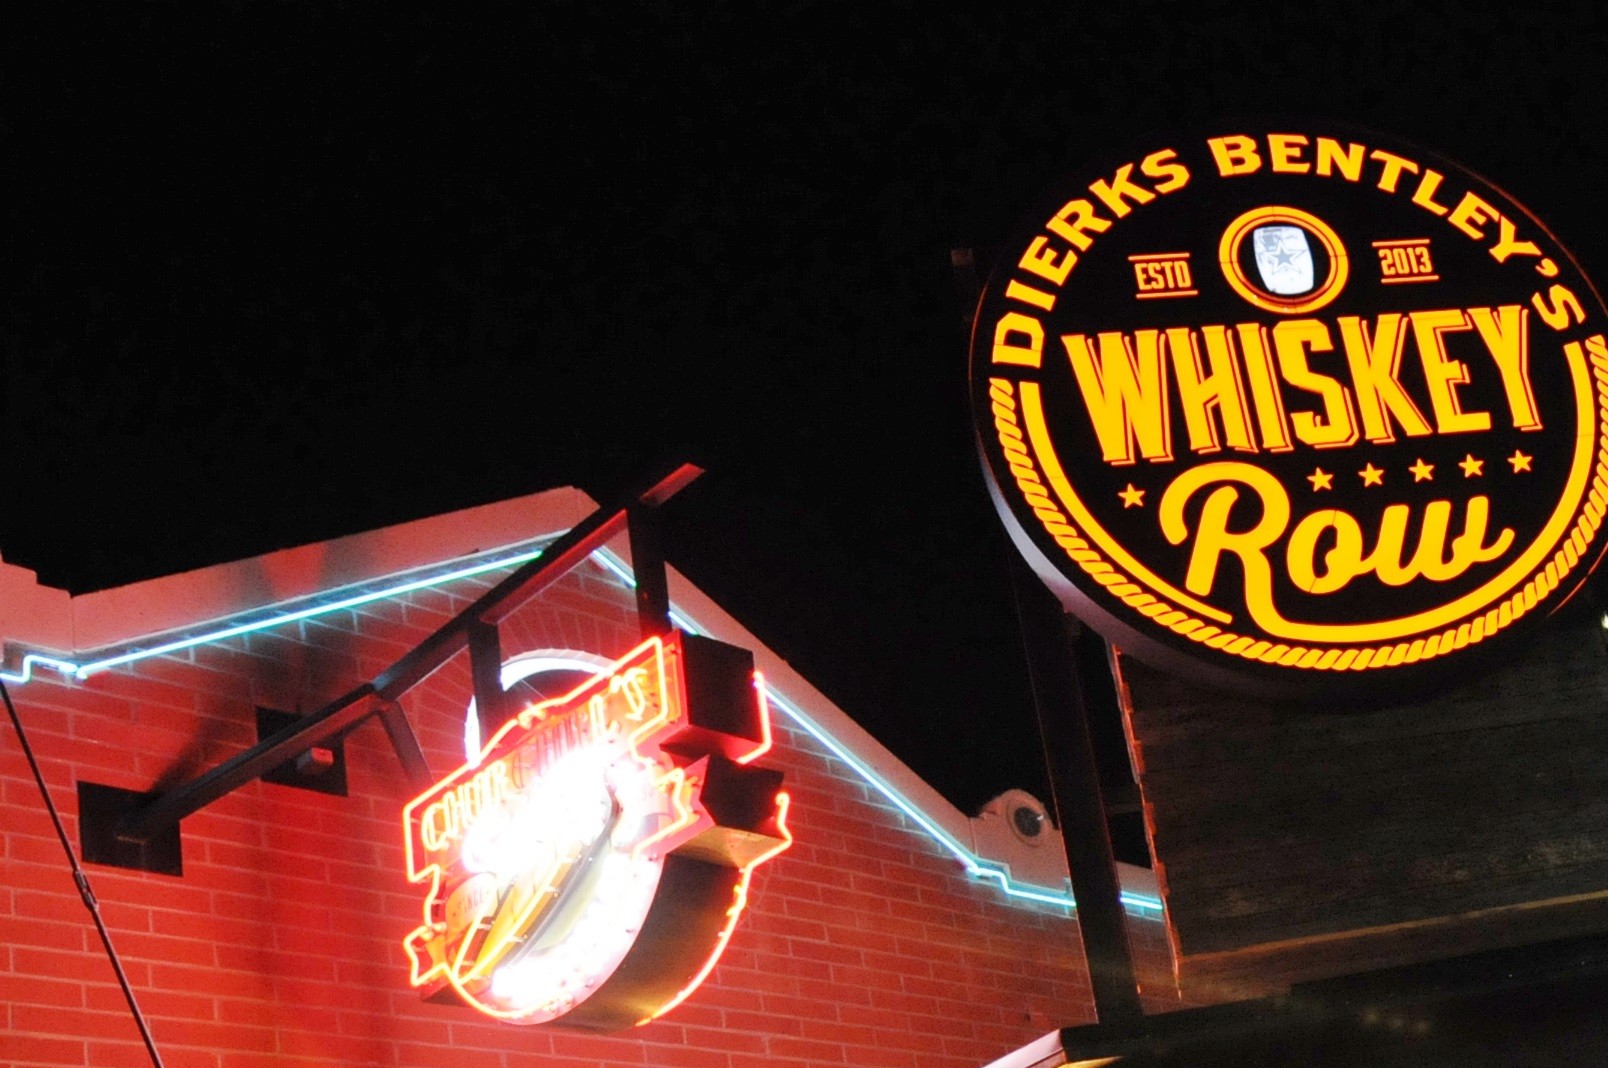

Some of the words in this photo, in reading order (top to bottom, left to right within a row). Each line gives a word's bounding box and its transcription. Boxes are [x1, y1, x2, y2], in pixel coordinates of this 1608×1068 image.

[992, 148, 1191, 370] DIERKS
[1207, 133, 1586, 331] BENTLEY'S
[1134, 260, 1192, 291] ESTD
[1378, 246, 1433, 275] 2013
[1061, 305, 1542, 465] WHISKEY
[1159, 461, 1515, 604] Row
